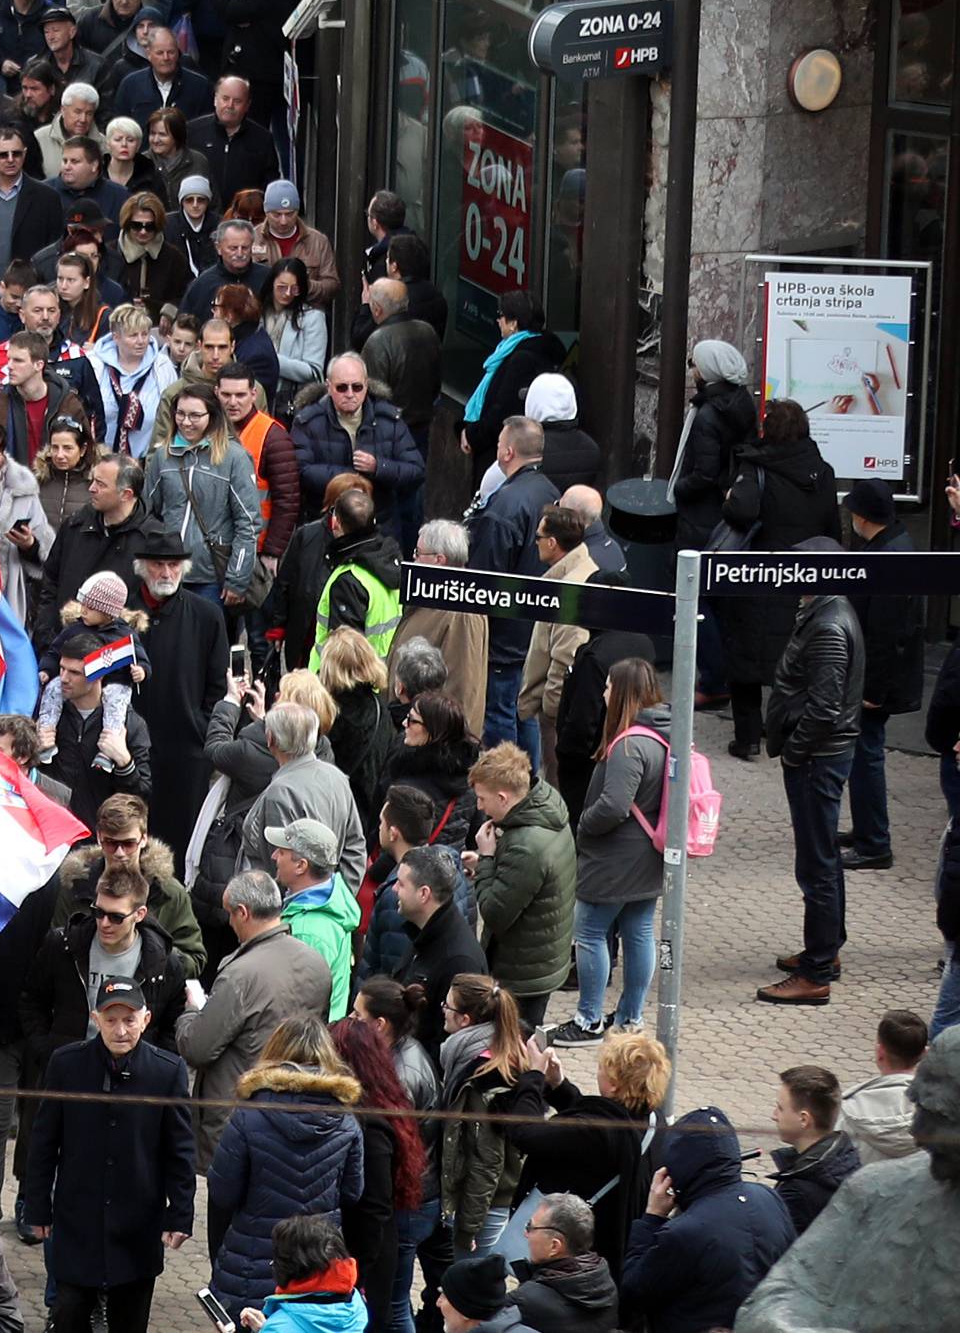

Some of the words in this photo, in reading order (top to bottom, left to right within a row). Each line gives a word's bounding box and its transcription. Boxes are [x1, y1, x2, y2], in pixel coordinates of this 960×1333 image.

[579, 15, 625, 37] ZONA
[628, 11, 662, 31] 0-24
[562, 50, 602, 65] Bankomat
[631, 47, 659, 63] HPB
[582, 67, 601, 79] ATM
[467, 140, 527, 213] ZONA
[465, 202, 526, 286] 0-24
[776, 282, 835, 296] HPB-ova
[839, 282, 874, 297] škola
[776, 296, 821, 309] crtanja
[825, 298, 863, 310] stripa
[877, 458, 898, 468] HPB
[715, 563, 817, 588] Petrinjska
[821, 567, 867, 581] ULICA
[412, 576, 511, 609] Jurišićeva
[515, 593, 560, 610] ULICA
